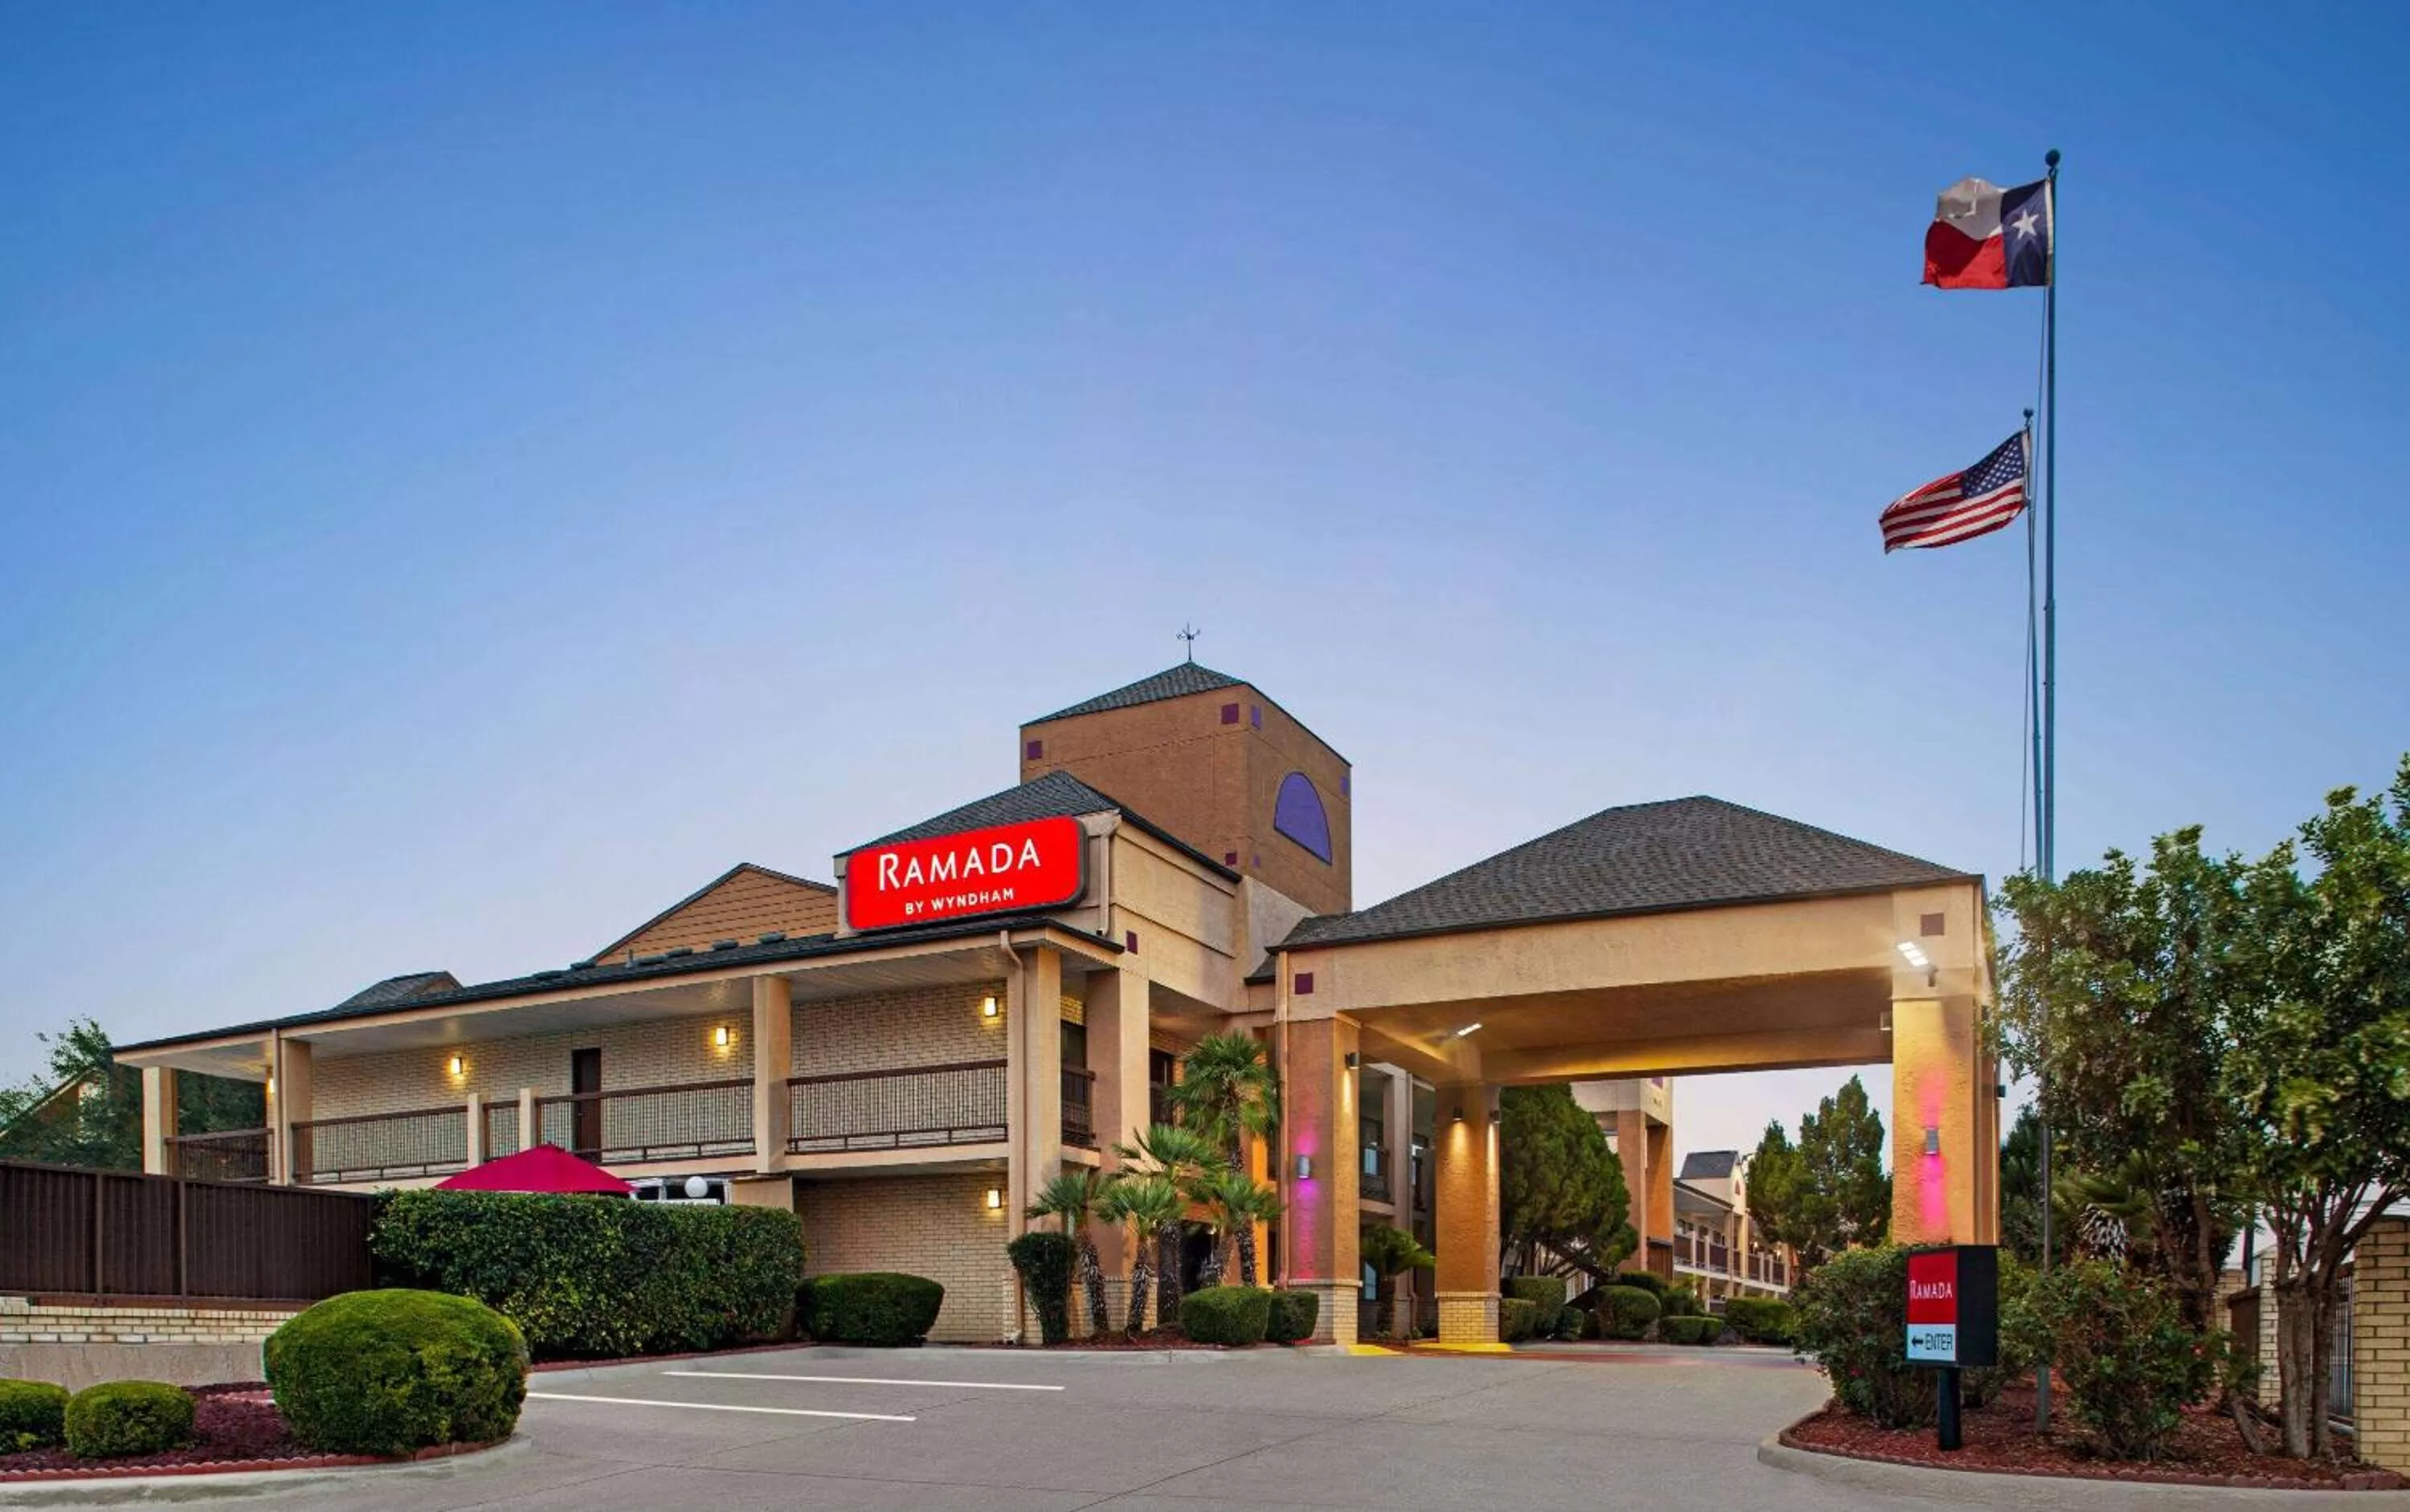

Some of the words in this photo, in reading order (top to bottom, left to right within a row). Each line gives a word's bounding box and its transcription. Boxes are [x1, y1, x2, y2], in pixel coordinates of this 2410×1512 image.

[878, 838, 1041, 891] RAMADA
[905, 901, 924, 914] BY
[932, 888, 1015, 910] WYNDHAM
[1910, 1280, 1953, 1299] RAMADA
[1925, 1333, 1953, 1351] ENTER
